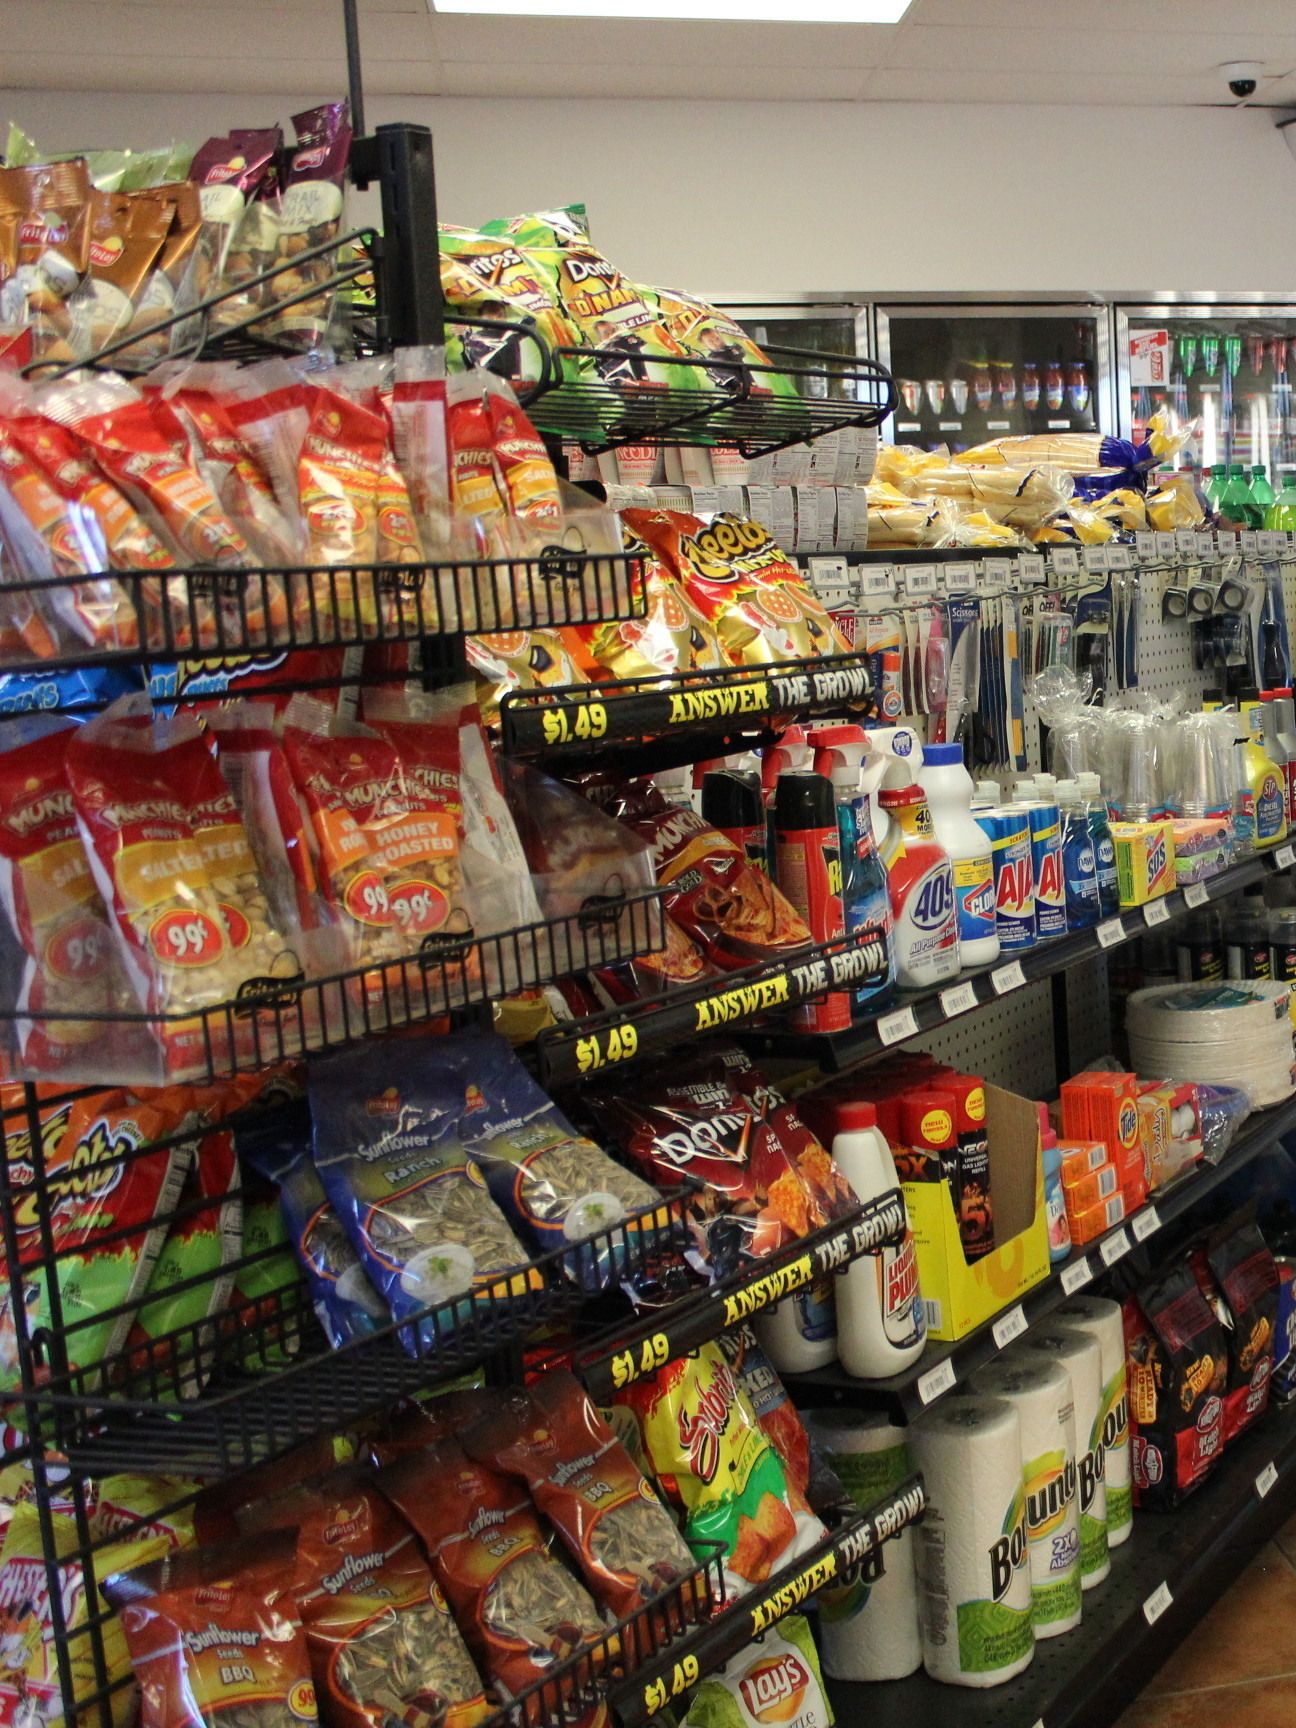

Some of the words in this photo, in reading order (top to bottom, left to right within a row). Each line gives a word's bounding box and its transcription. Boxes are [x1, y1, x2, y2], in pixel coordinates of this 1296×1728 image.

[470, 248, 523, 275] ritos
[682, 516, 776, 578] Cheeto
[952, 607, 979, 618] Scissors
[669, 681, 771, 723] ANSWER
[773, 675, 811, 708] THE
[814, 667, 876, 703] GROWL
[543, 704, 607, 745] $1.49
[1264, 779, 1277, 797] STP
[7, 793, 76, 831] MUNC
[375, 821, 439, 847] HONEY
[996, 854, 1033, 911] AJA
[1038, 850, 1064, 900] AJ
[696, 973, 790, 1031] ANSWER
[792, 965, 829, 997] THE
[831, 941, 890, 983] GROWL
[576, 1024, 638, 1073] $1.49
[357, 1131, 430, 1161] Sunflower
[1121, 1111, 1136, 1142] Tide
[384, 1156, 441, 1184] Ranch
[724, 1254, 813, 1327] ANSWER
[815, 1231, 850, 1272] THE
[852, 1203, 906, 1257] GROWL
[611, 1332, 669, 1388] $1.49
[549, 1454, 597, 1487] Sunflower
[1026, 1456, 1077, 1530] unty
[322, 1551, 384, 1594] Sunflower
[751, 1552, 841, 1637] ANSWER
[838, 1529, 873, 1564] THE
[875, 1487, 926, 1541] GROWL
[185, 1623, 260, 1654] Sunflower
[220, 1667, 256, 1684] BBQ
[645, 1654, 699, 1716] $1.49
[744, 1657, 801, 1715] Lay's
